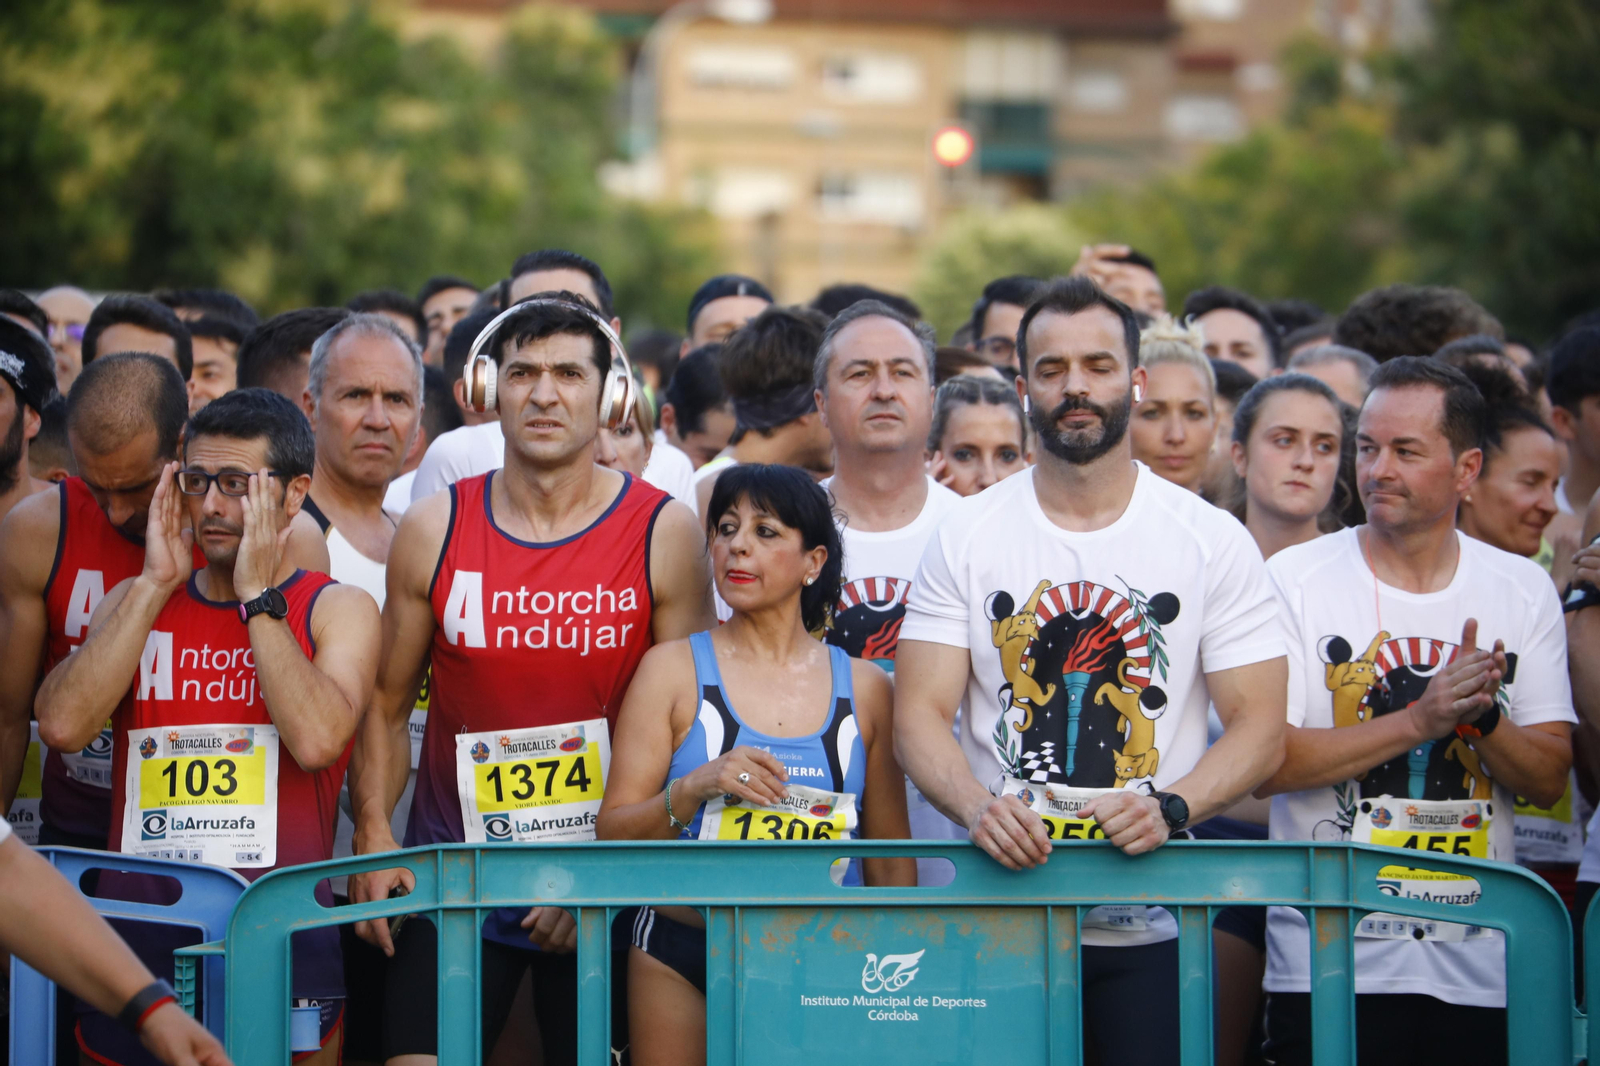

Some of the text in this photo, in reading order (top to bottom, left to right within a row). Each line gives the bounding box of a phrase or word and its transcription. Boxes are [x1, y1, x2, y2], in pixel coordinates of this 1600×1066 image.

[171, 738, 222, 750] TROTACALLES
[503, 740, 556, 754] TROTACALLES
[162, 758, 238, 798] 103
[486, 756, 592, 802] 1374
[784, 766, 825, 778] IERRA
[170, 816, 256, 830] laArruzafa
[515, 811, 598, 834] laArruzafa
[734, 812, 834, 840] 1306
[1409, 814, 1459, 825] TROTACALLES
[1411, 872, 1434, 880] JAVIER
[800, 995, 987, 1010] Instituto Municipal de Deportes
[868, 1010, 919, 1021] Córdoba
